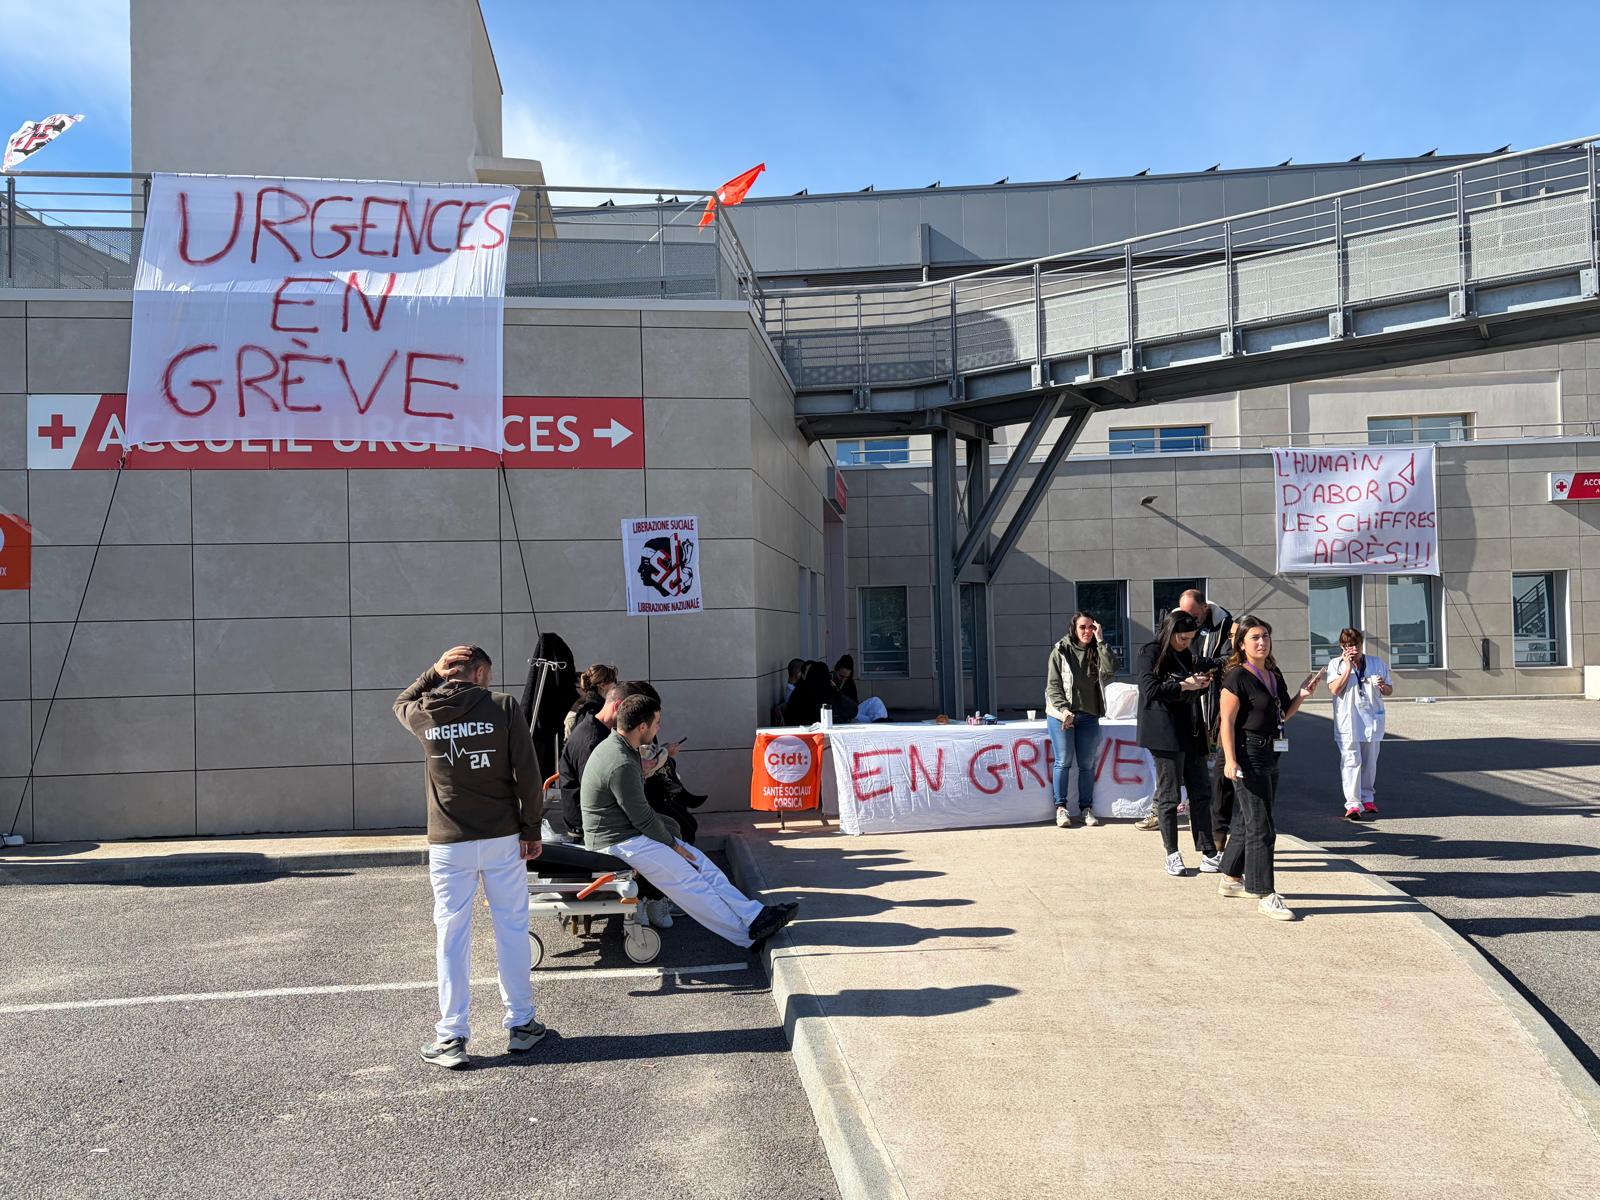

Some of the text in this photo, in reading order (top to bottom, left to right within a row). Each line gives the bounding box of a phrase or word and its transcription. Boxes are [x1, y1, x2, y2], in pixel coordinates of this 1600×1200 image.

[178, 187, 511, 265] URGENCES
[271, 272, 396, 333] EN
[162, 338, 465, 420] GRÈVE
[1282, 479, 1408, 507] D'ABORD
[632, 520, 670, 534] LIBERAZIONE
[1282, 512, 1329, 533] LES
[637, 601, 671, 613] LIBERAZIONE
[425, 721, 494, 741] URGENCES
[469, 752, 491, 770] 2A
[851, 744, 944, 801] EN
[763, 784, 784, 796] SANTÉ
[773, 797, 803, 808] CORSICA
